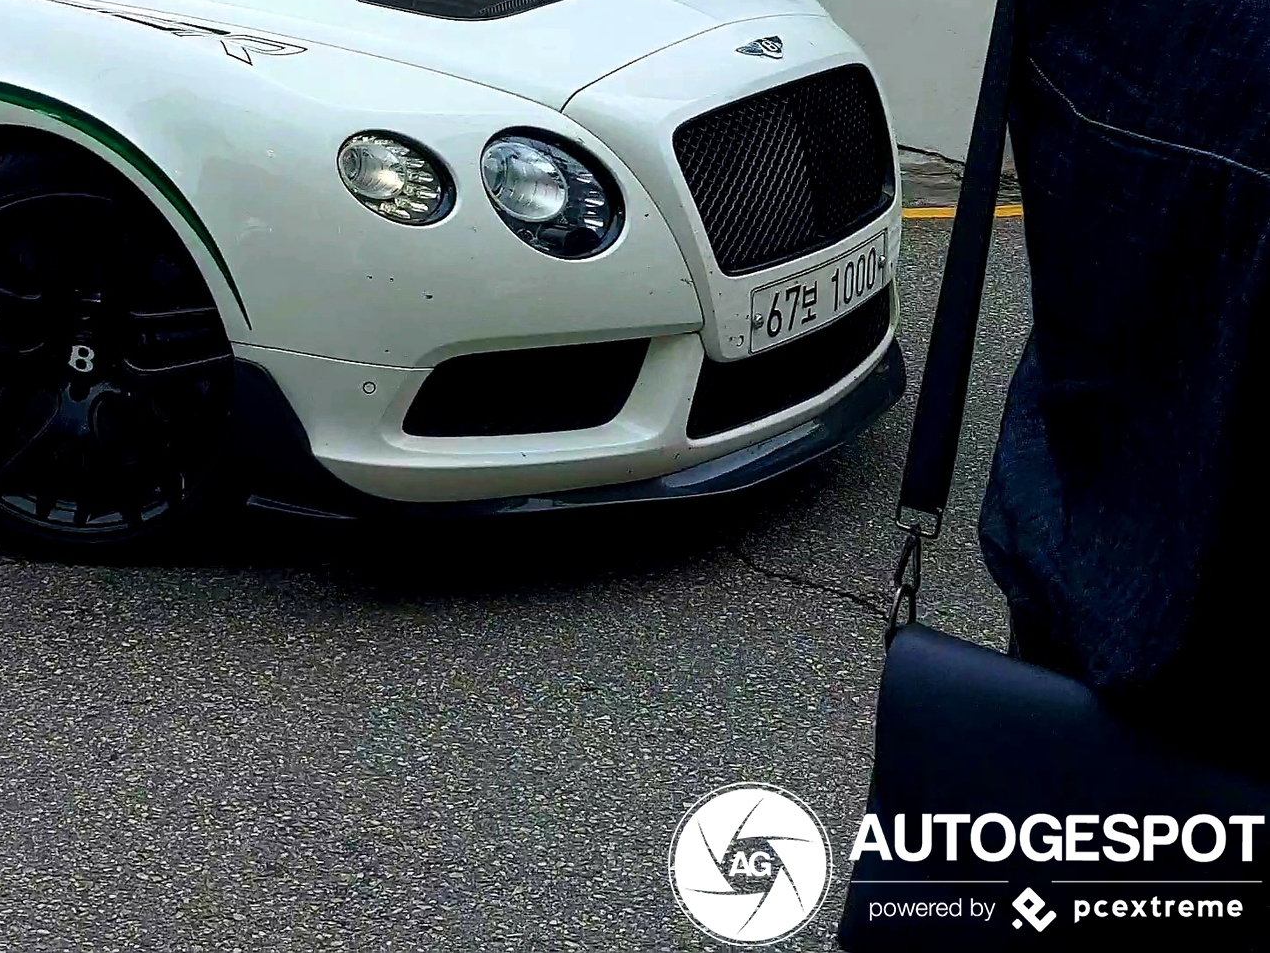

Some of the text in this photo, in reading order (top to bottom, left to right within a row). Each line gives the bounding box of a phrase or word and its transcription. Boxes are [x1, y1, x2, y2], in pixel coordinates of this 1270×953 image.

[766, 247, 877, 338] 67보 1000
[68, 344, 95, 373] B
